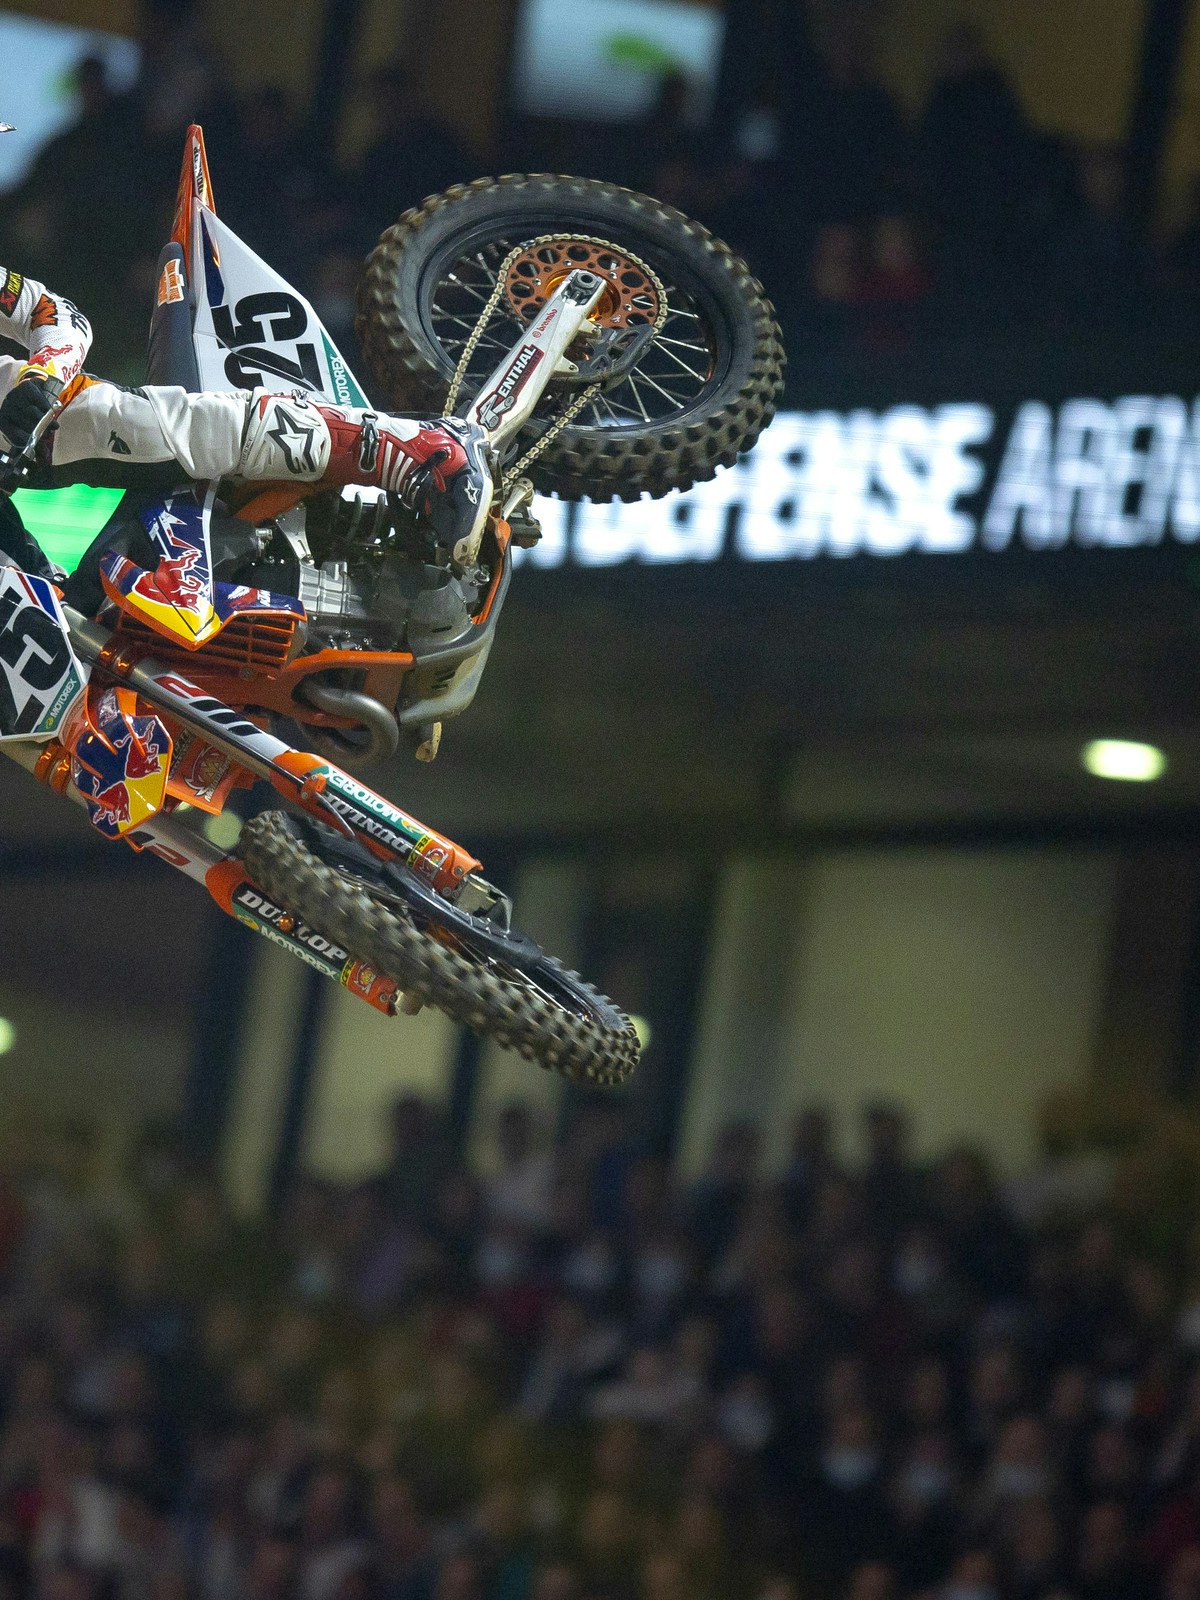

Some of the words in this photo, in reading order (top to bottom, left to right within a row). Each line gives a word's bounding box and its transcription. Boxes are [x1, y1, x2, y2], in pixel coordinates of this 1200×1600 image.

[210, 291, 325, 392] 25
[537, 308, 558, 332] brembo
[50, 678, 77, 718] MOTOREX
[326, 766, 401, 822] MOTOREX
[238, 890, 348, 960] DULOP
[260, 925, 338, 981] MOTOREX
